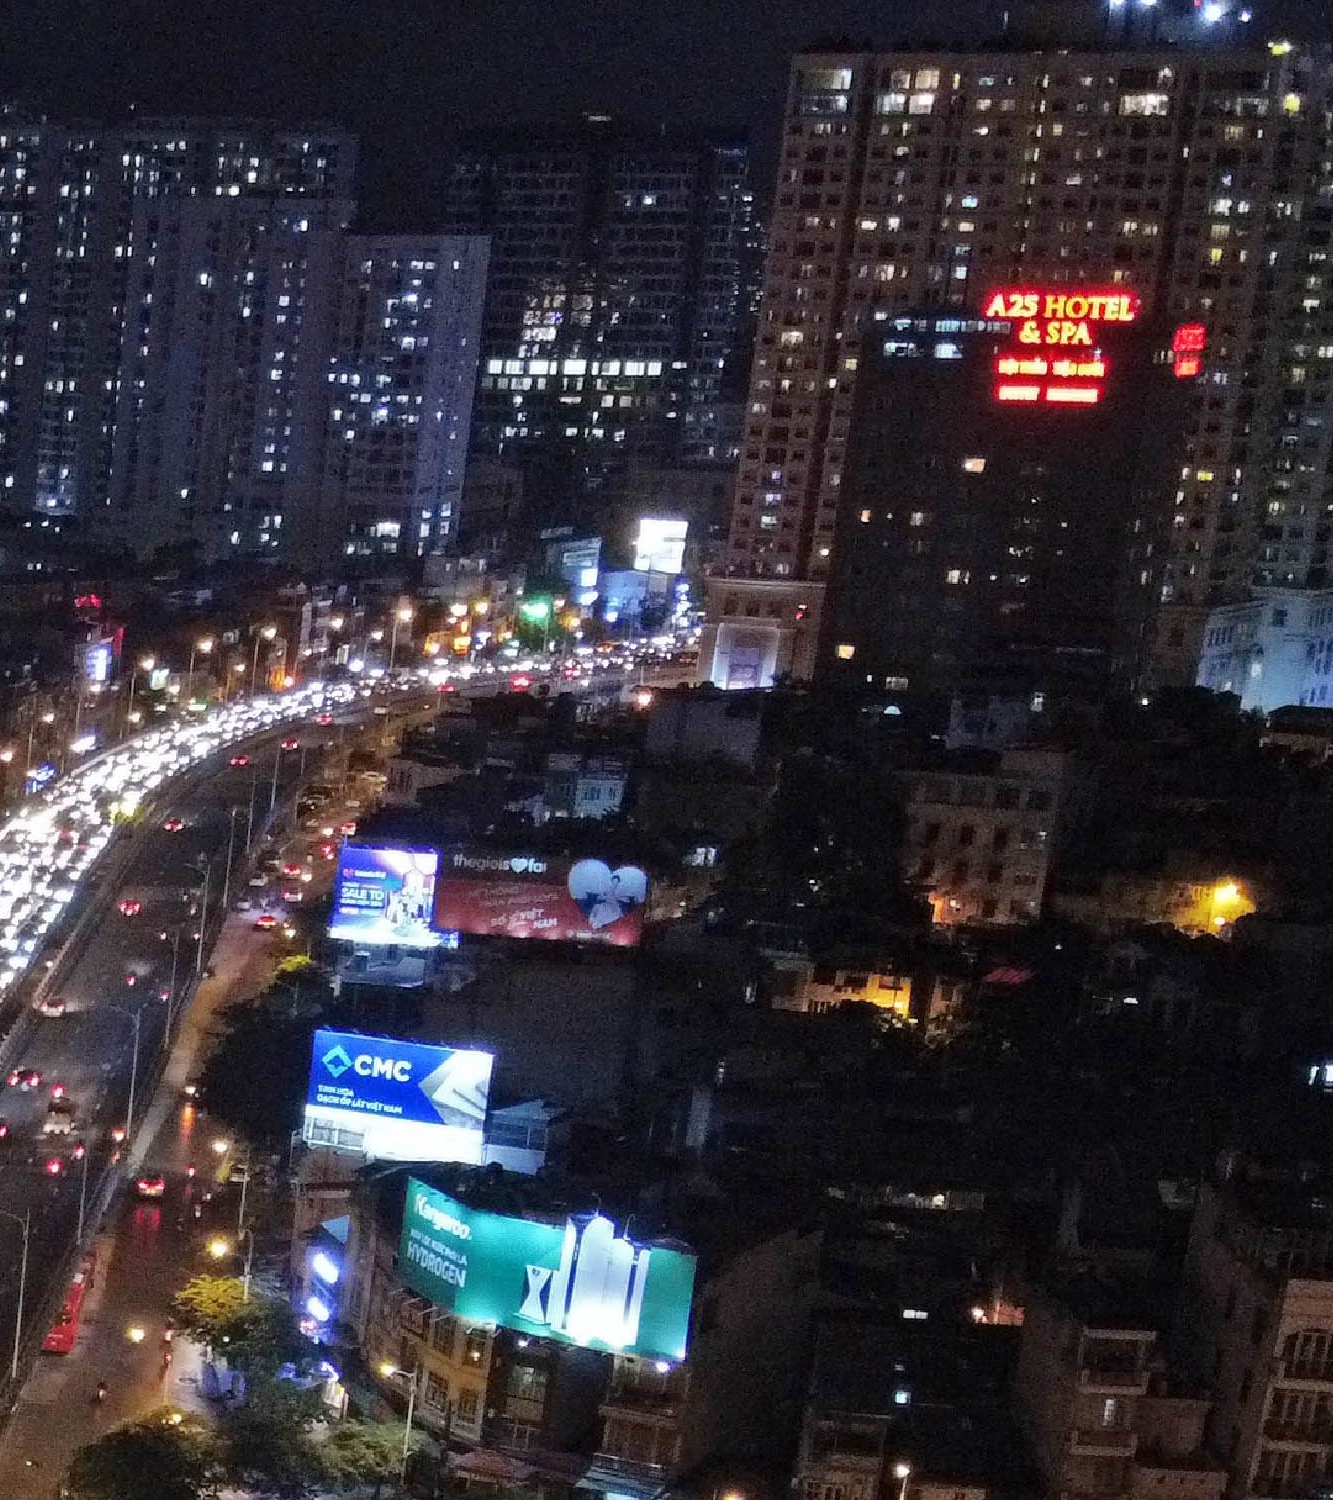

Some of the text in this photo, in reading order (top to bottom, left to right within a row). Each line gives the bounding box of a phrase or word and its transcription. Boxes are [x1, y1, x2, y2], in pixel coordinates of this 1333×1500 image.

[986, 293, 1135, 321] A25 HOTEL
[1019, 321, 1092, 344] & SPA
[354, 1054, 412, 1082] CMC
[407, 1240, 467, 1288] HYDROGEN
